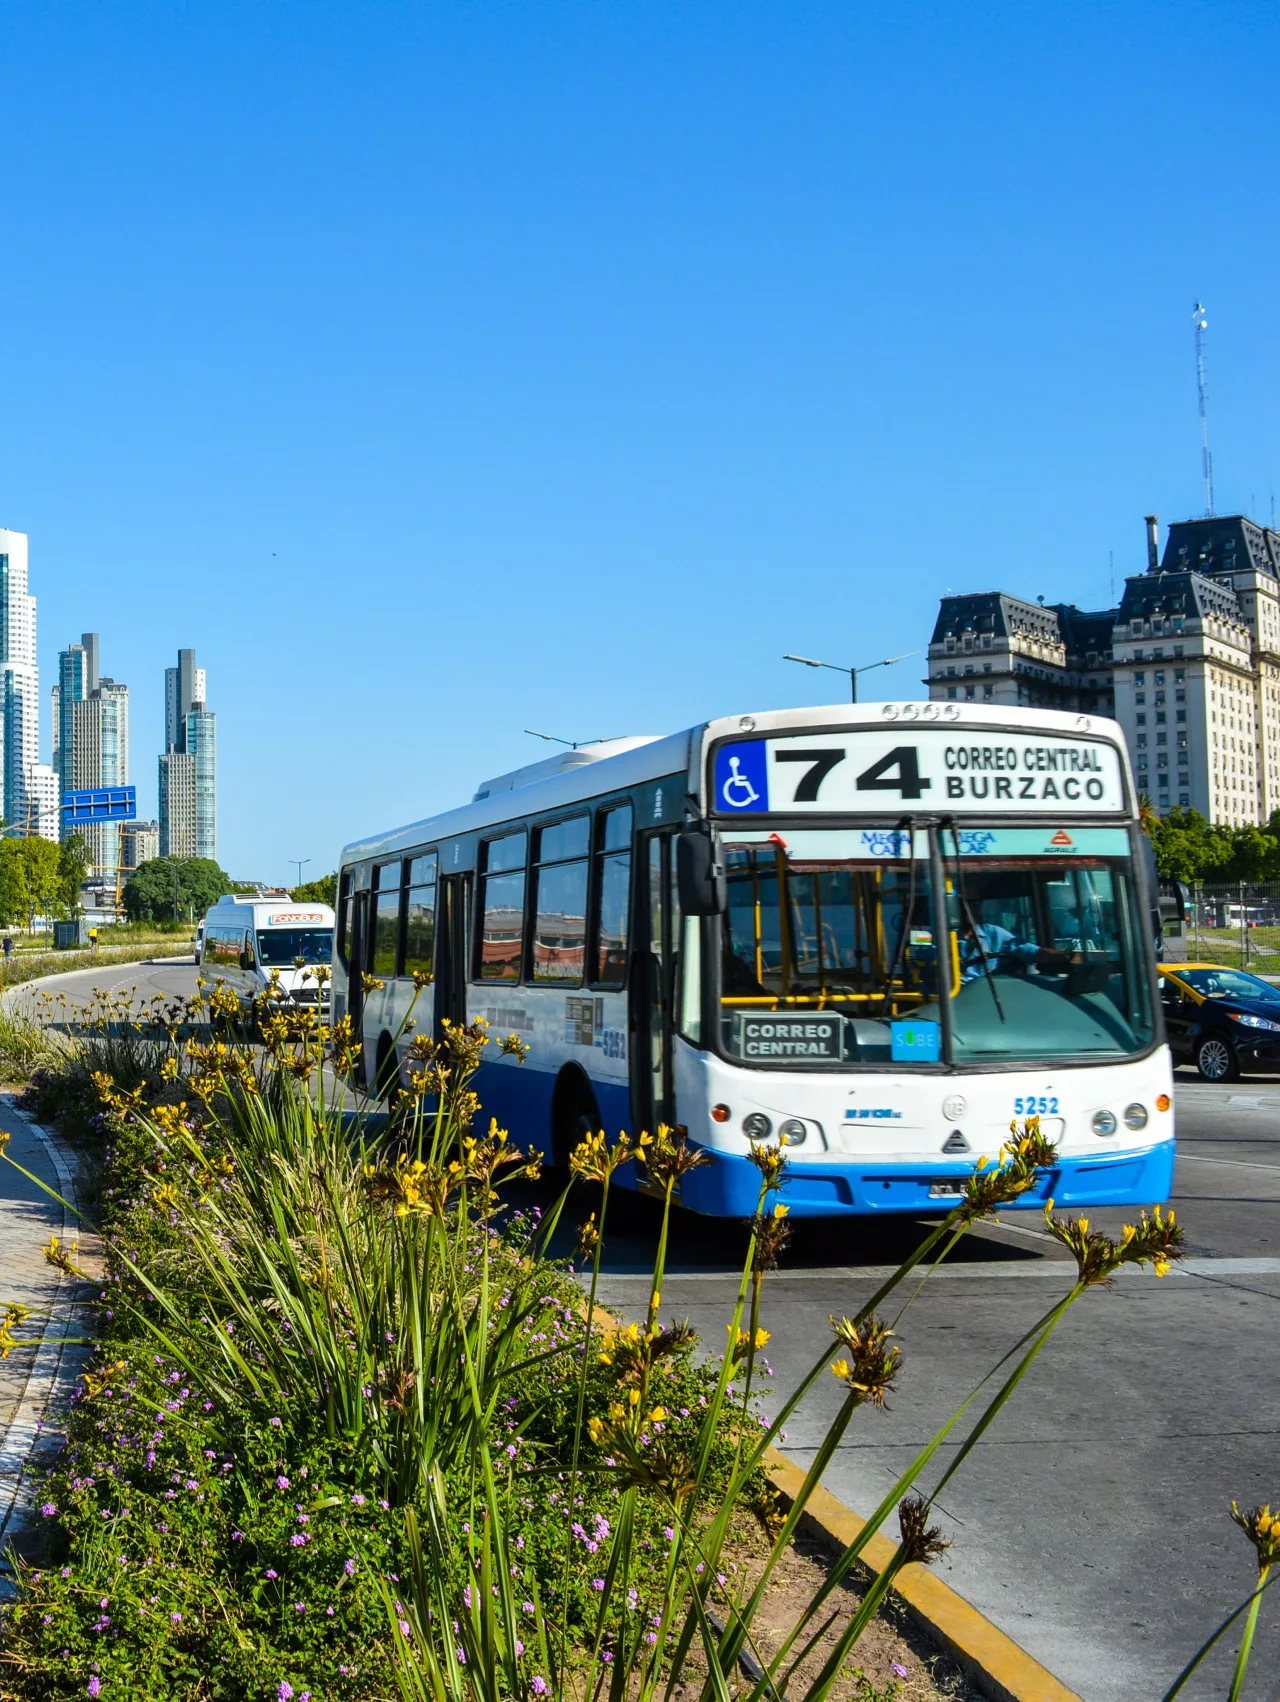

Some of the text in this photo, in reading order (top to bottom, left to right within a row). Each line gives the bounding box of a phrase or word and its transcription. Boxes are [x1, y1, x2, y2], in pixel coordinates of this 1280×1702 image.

[945, 746, 1102, 772] CORREO CENTRAL
[775, 746, 931, 802] 74
[947, 776, 1104, 801] BURZACO
[861, 832, 912, 844] MEGA
[746, 1024, 832, 1038] CORREO
[895, 1030, 935, 1047] SUBE
[746, 1042, 830, 1055] CENTRAL
[1014, 1096, 1059, 1115] 5252
